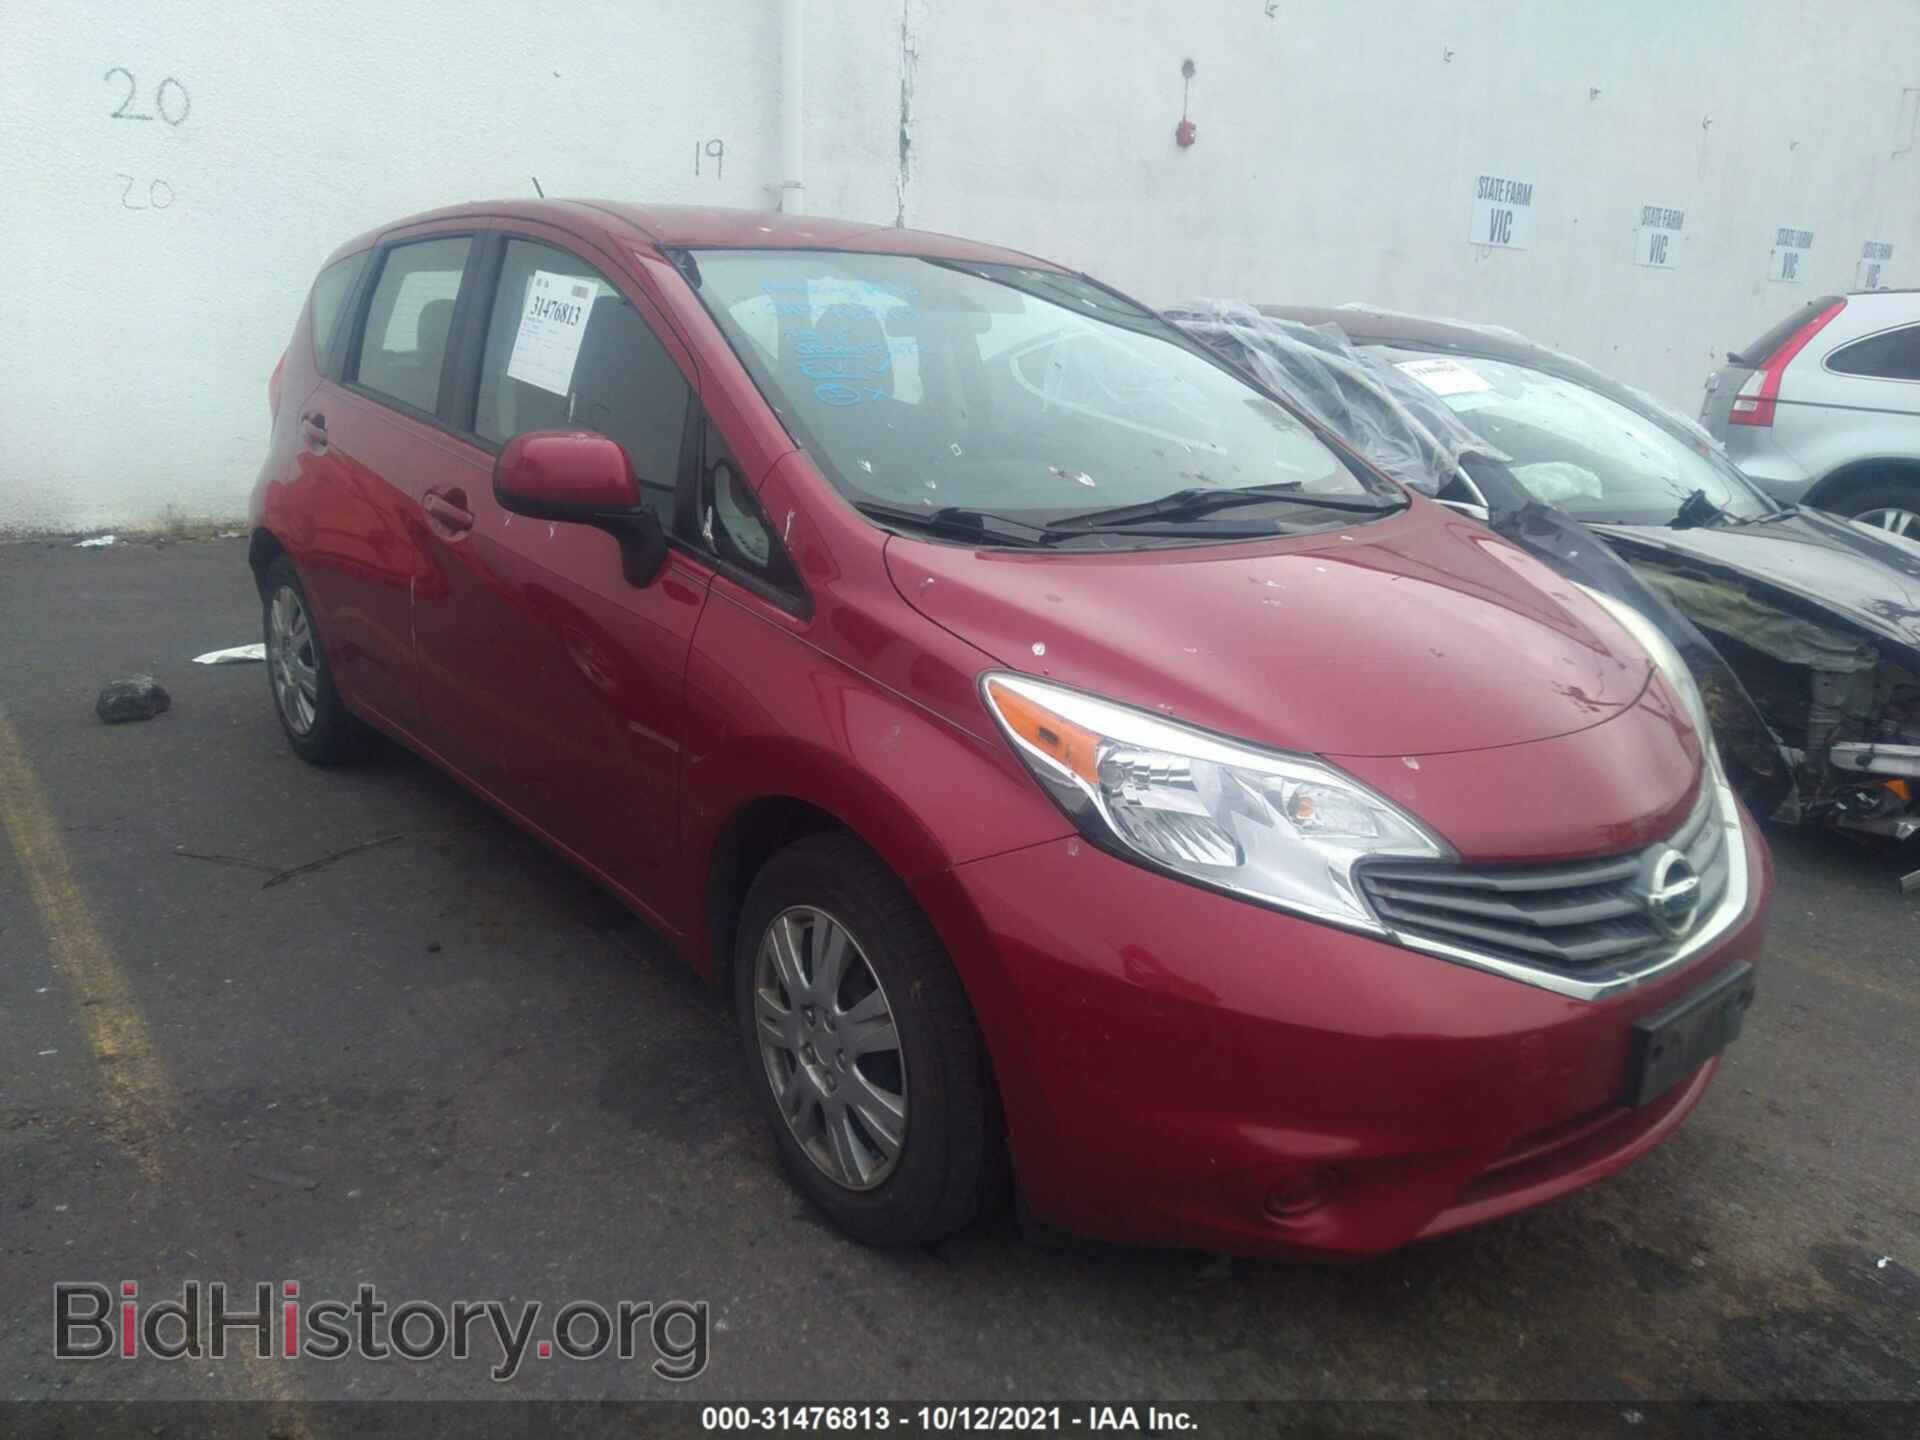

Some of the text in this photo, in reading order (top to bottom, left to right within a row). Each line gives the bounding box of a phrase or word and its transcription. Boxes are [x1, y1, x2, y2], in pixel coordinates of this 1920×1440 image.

[104, 67, 191, 126] 20
[695, 138, 724, 181] 19
[1477, 175, 1534, 207] STATE FARM
[1489, 207, 1513, 244] VIC
[1641, 205, 1686, 231] STATE FARM
[1649, 233, 1669, 264] VIC
[1782, 252, 1799, 279] VIC
[529, 295, 582, 327] 31476813
